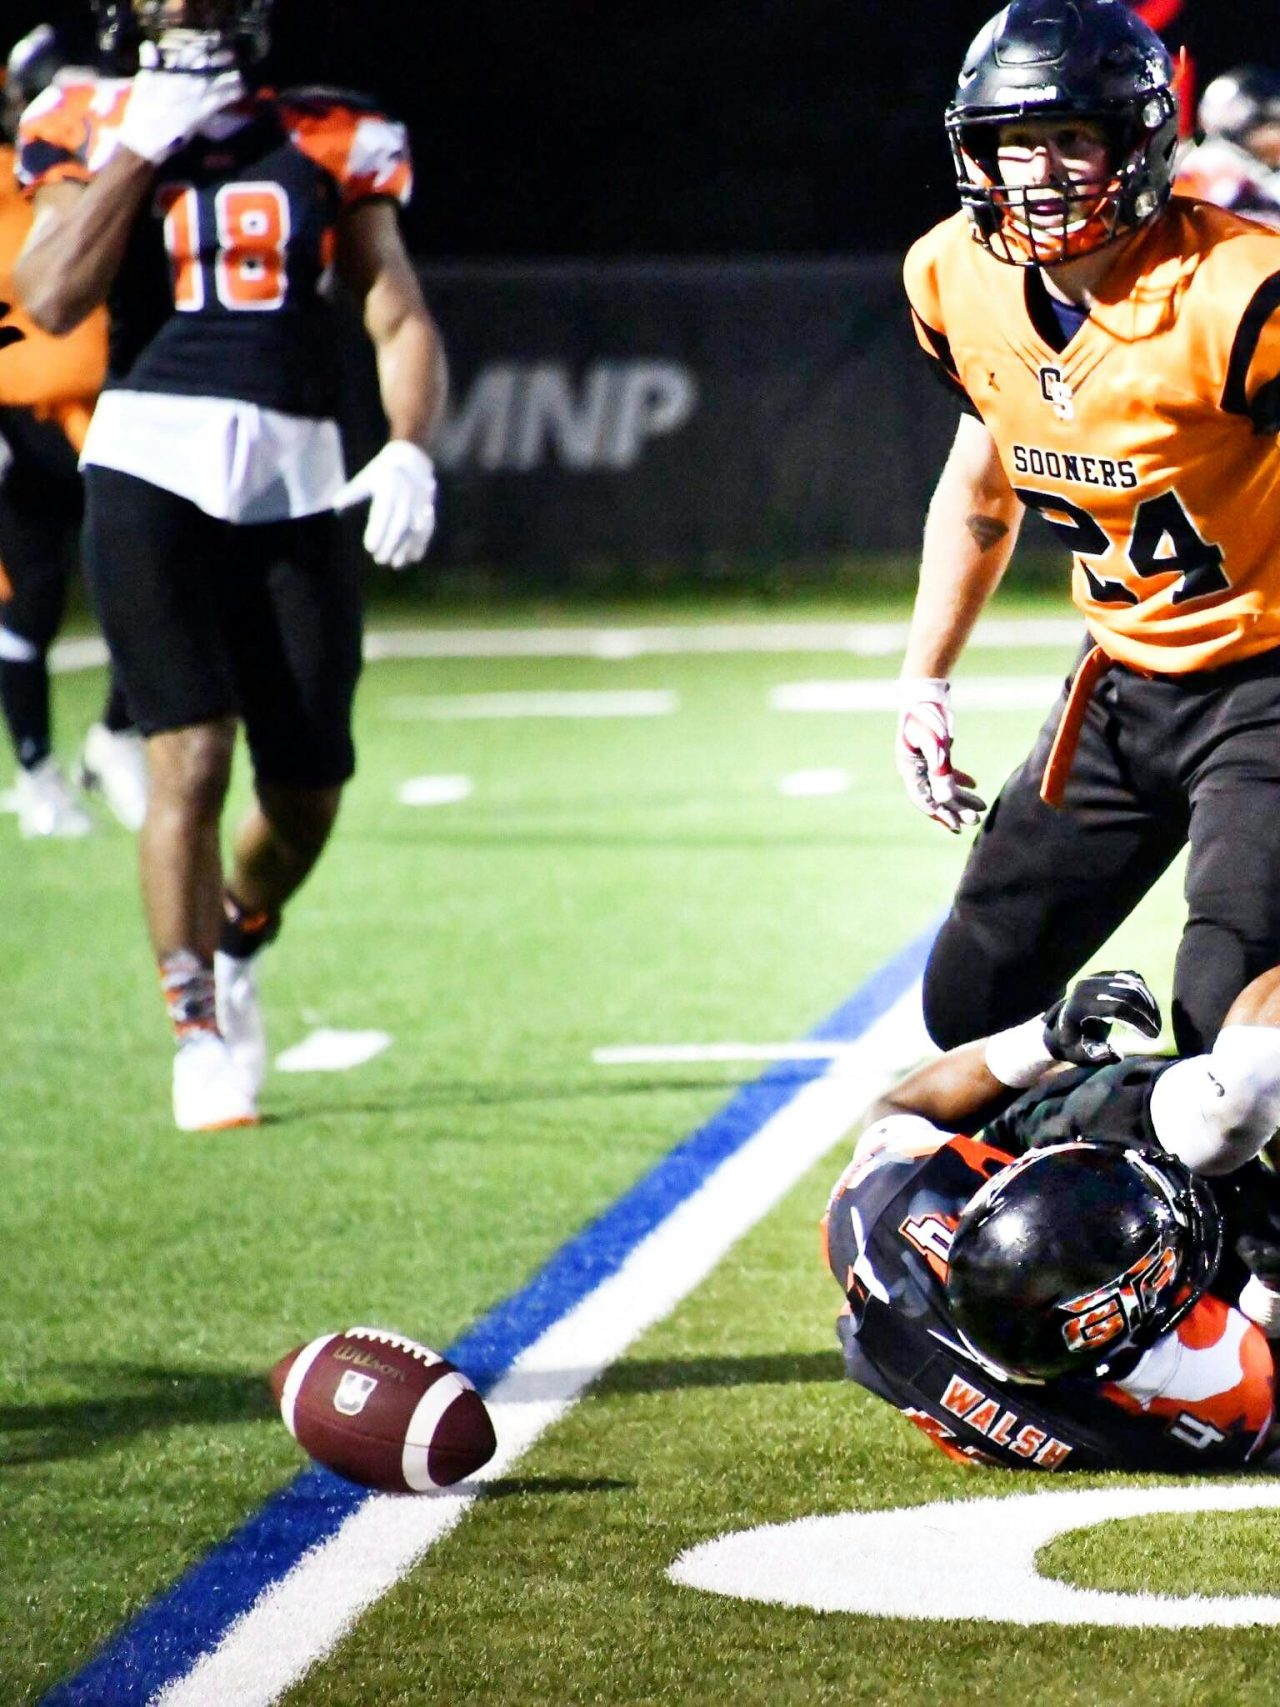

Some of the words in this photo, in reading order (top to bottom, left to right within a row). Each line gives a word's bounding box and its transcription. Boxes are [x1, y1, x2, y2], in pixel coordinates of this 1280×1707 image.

[161, 180, 291, 312] 18
[1012, 444, 1139, 489] SOONERS
[1013, 485, 1232, 606] 24
[940, 1373, 1073, 1472] WALSH
